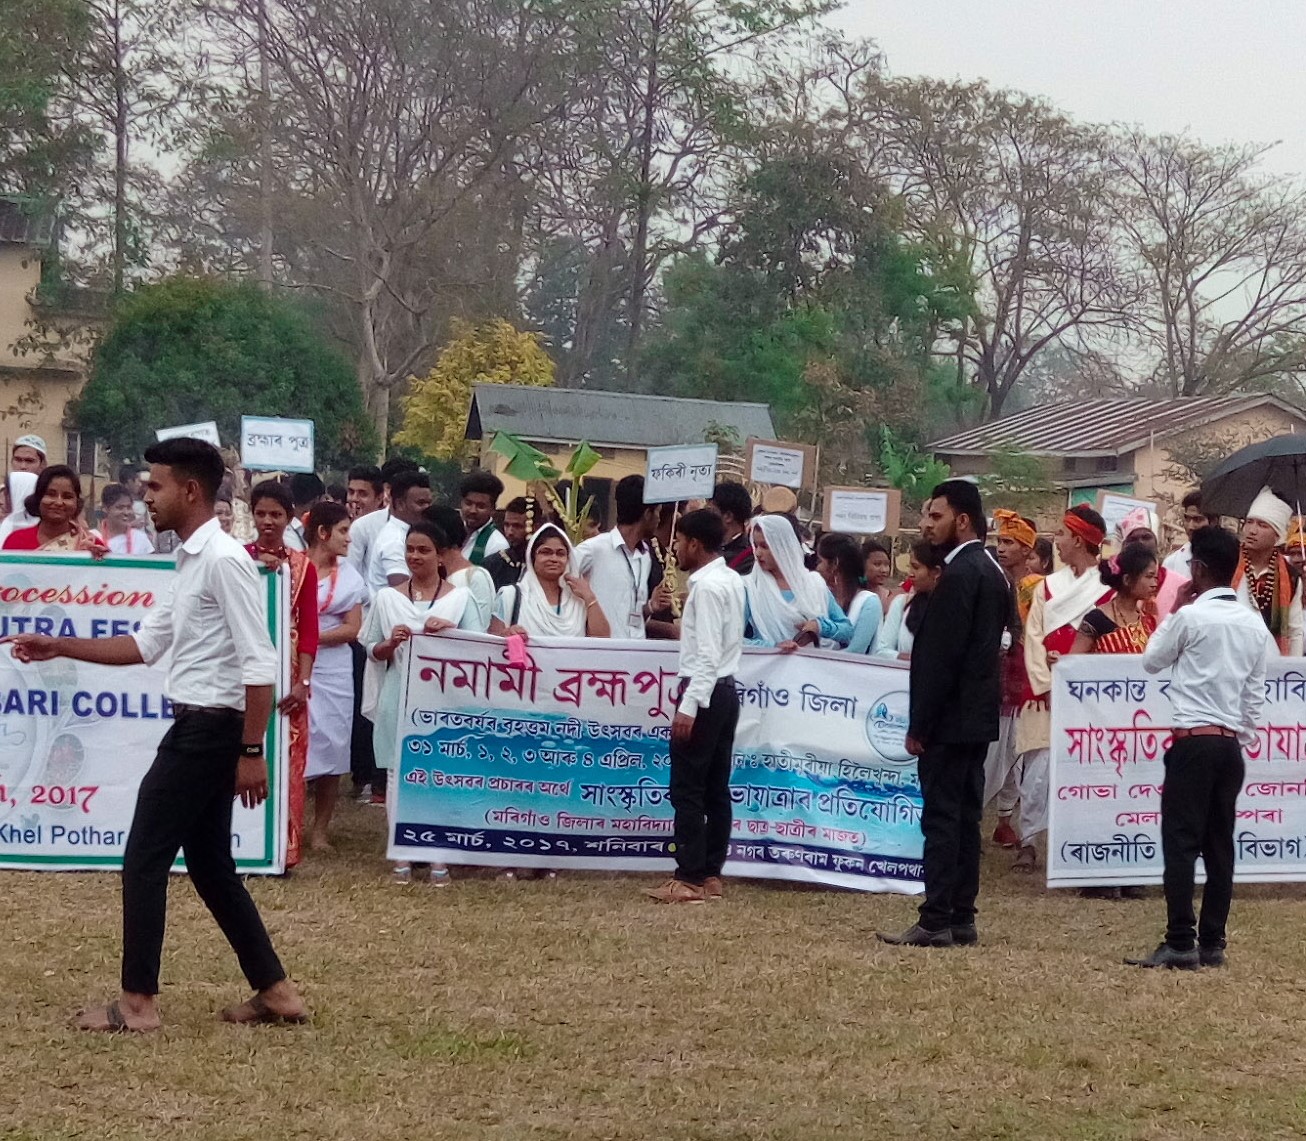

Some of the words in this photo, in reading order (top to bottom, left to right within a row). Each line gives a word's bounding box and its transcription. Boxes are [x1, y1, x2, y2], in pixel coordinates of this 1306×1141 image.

[0, 583, 155, 608] ocession
[0, 689, 58, 716] ARI
[799, 683, 859, 719] জিলা
[1066, 676, 1149, 704] ঘনকান্ত
[554, 717, 582, 739] নদী
[30, 784, 99, 813] 2017
[52, 825, 124, 846] Pothar
[1060, 833, 1157, 864] (ৰাজনীতি
